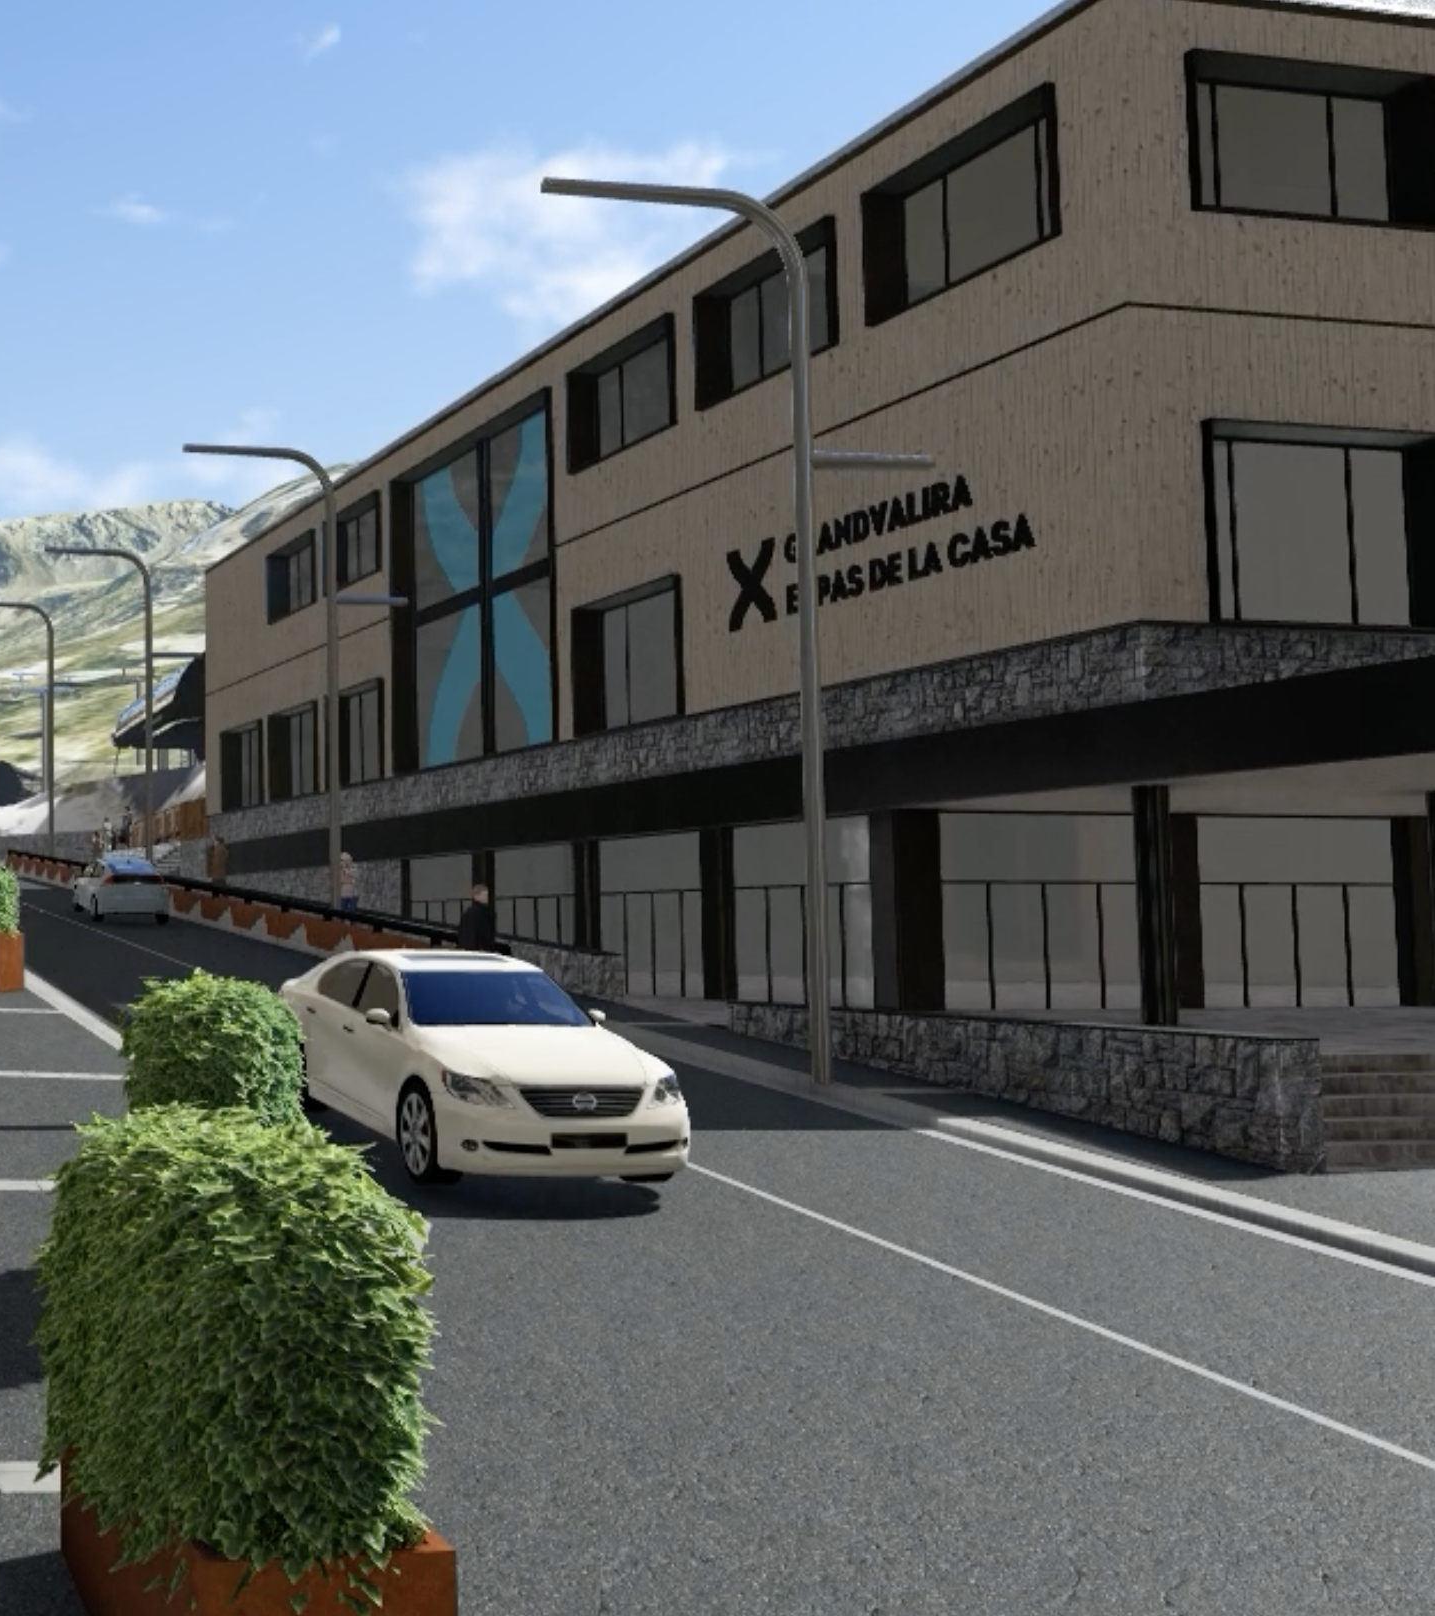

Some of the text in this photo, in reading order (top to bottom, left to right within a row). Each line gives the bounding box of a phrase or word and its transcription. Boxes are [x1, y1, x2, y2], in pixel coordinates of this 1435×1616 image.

[784, 475, 973, 563] GANDVALIRA
[817, 565, 865, 606] PAS
[869, 552, 903, 592] DE
[908, 542, 943, 581] LA
[947, 513, 1036, 568] CASA
